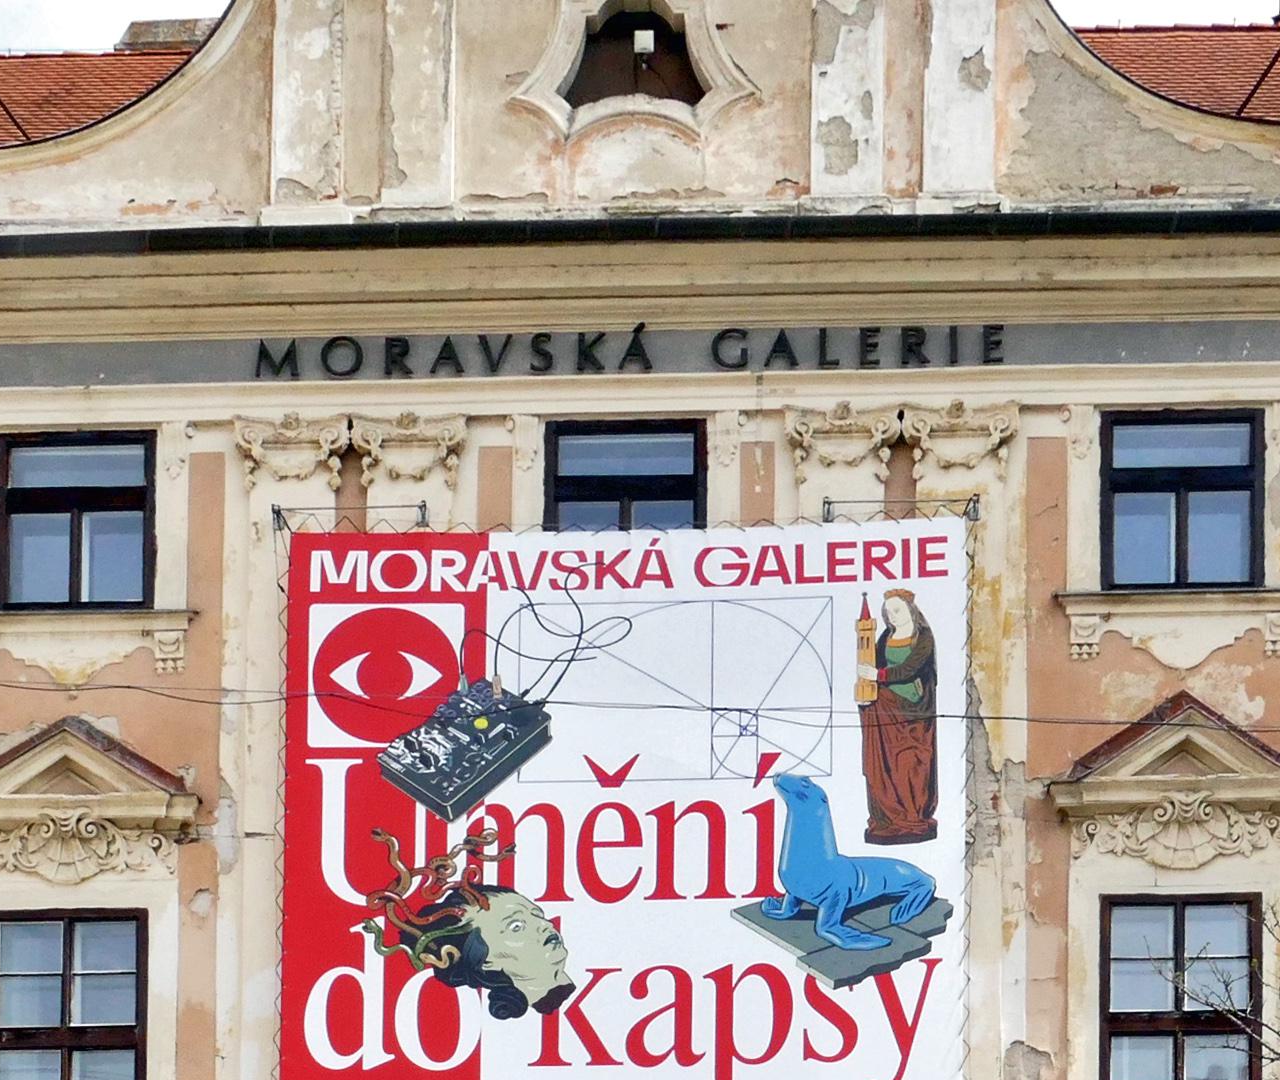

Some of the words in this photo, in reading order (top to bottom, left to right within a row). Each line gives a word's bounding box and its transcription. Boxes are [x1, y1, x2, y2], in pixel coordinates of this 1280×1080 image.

[255, 322, 652, 378] MORAVSKÁ
[711, 324, 1006, 370] GALERIE
[309, 538, 674, 593] MORAVSKÁ
[694, 536, 950, 588] GALERIE
[305, 752, 786, 907] Umění
[303, 916, 482, 1072] do
